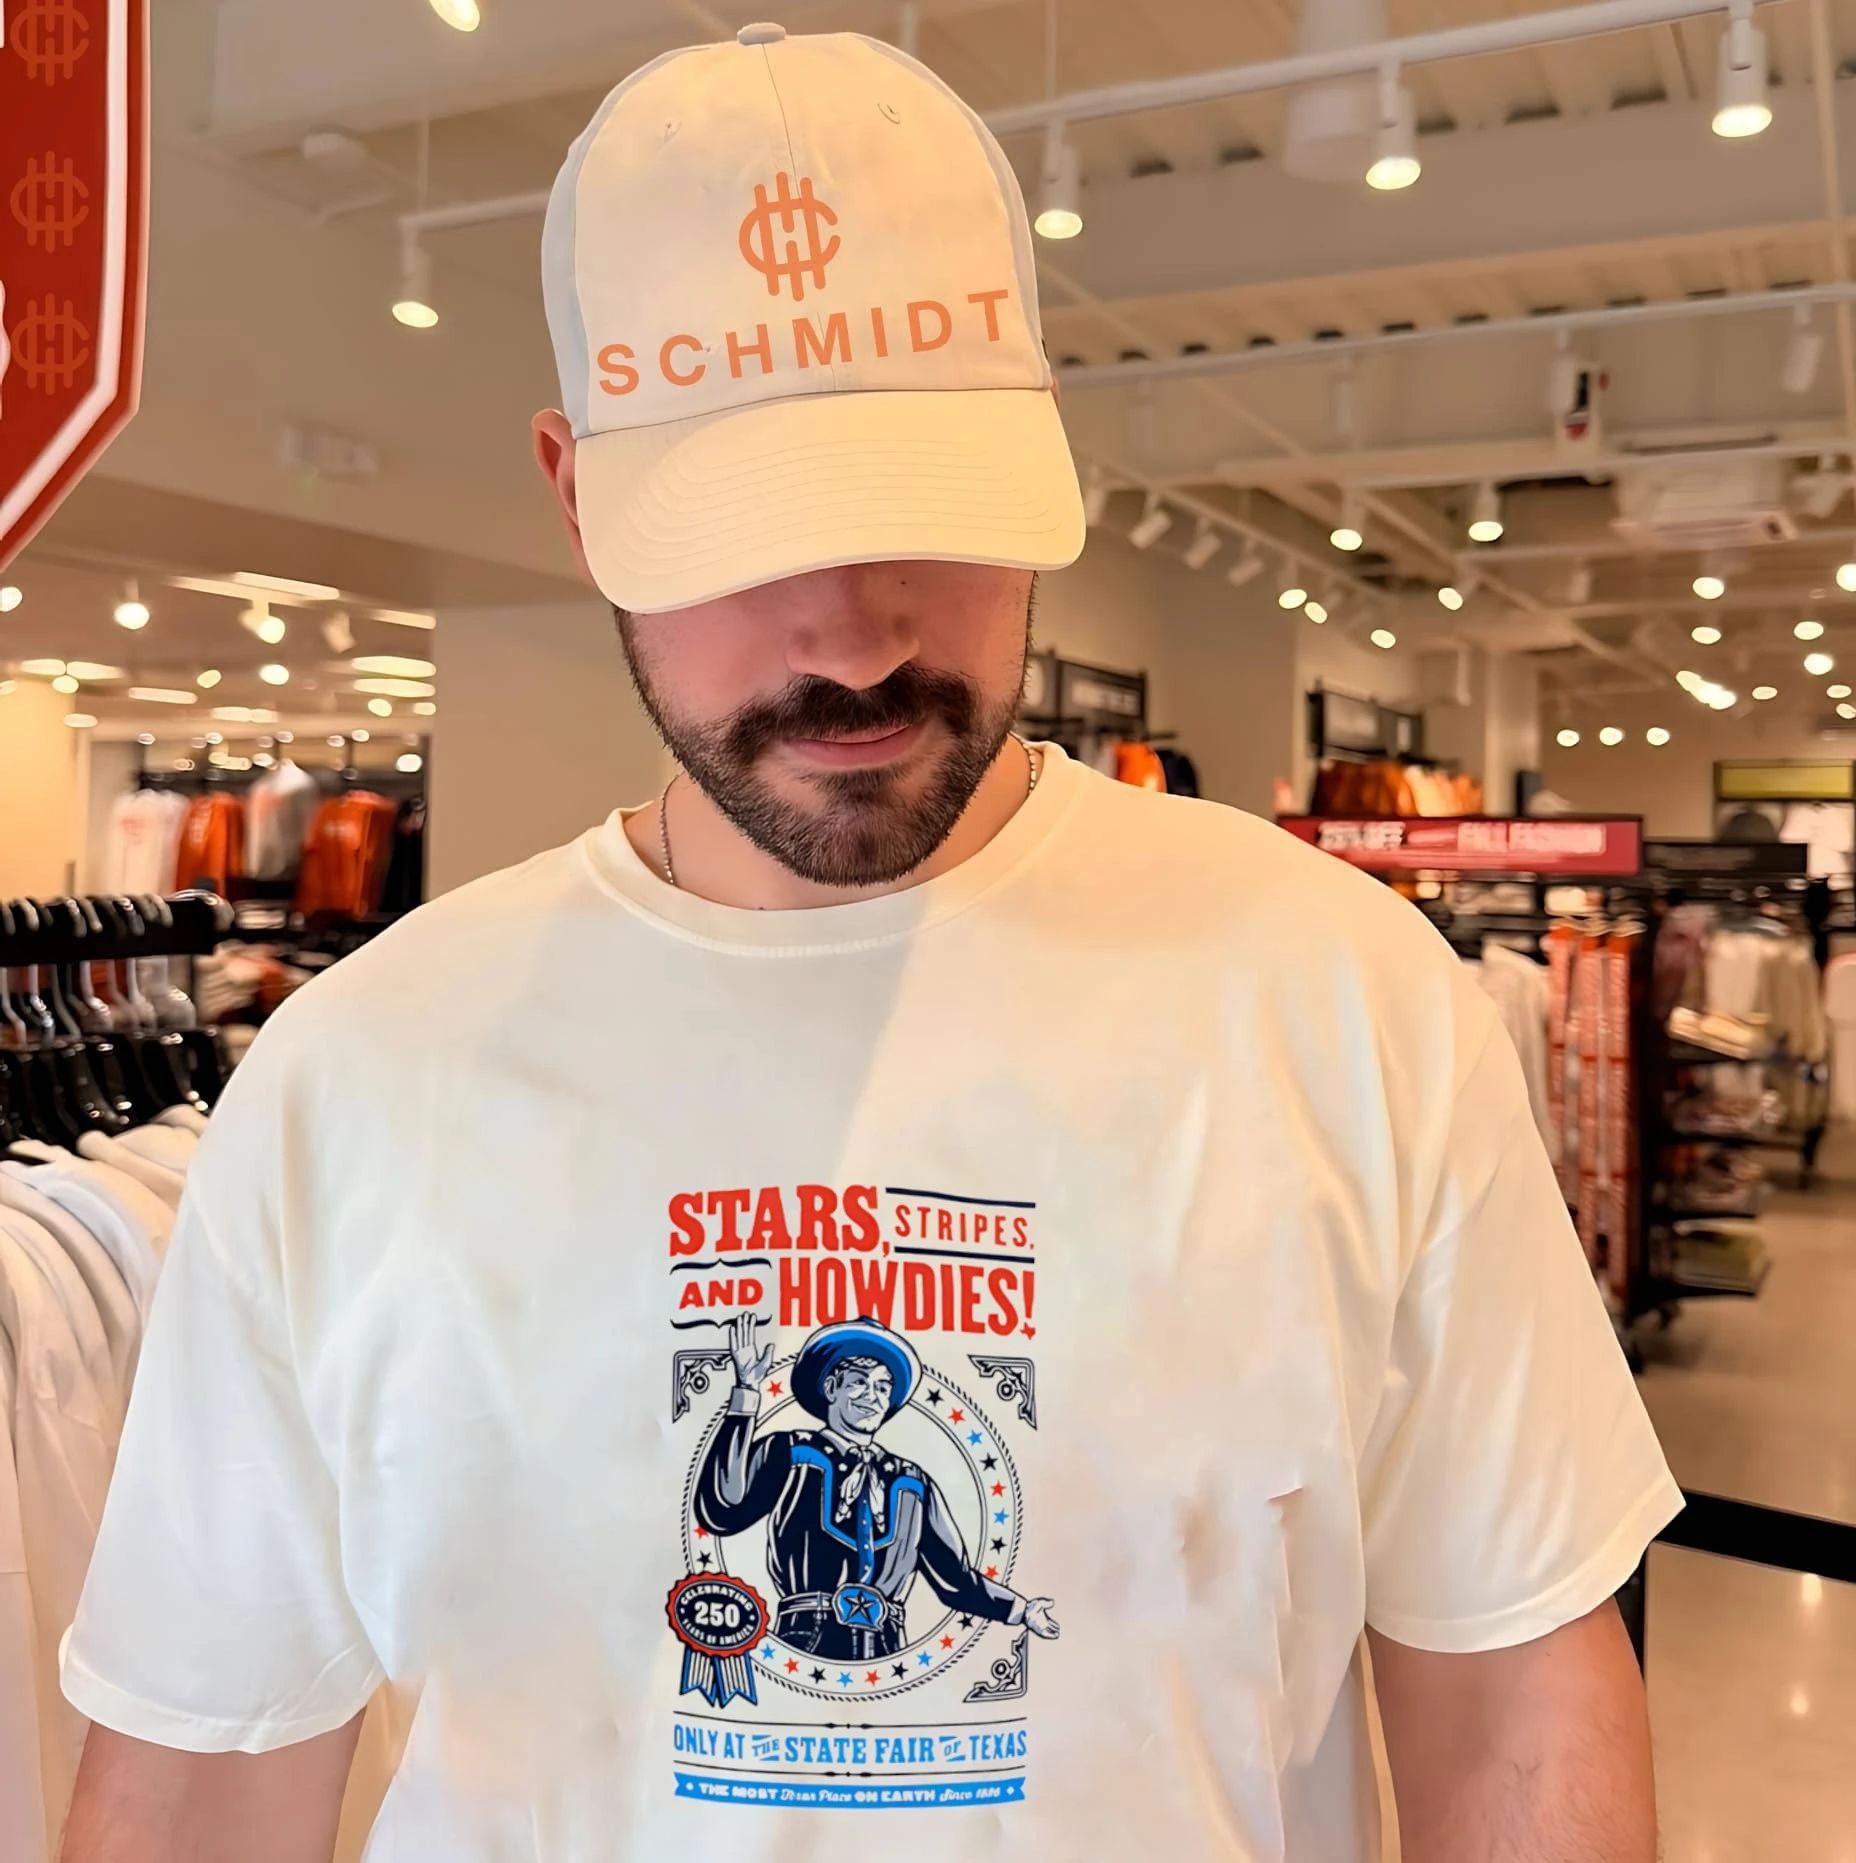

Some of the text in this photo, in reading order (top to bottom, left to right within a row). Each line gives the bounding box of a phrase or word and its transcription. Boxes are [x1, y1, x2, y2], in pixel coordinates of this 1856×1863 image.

[598, 289, 1010, 395] SCHMIDT
[669, 1184, 891, 1257] STARS,
[679, 1256, 1037, 1340] AND HOWDIES!
[694, 1601, 740, 1628] 250
[673, 1723, 719, 1757] ONLY
[723, 1731, 746, 1760] AT
[752, 1738, 780, 1757] THE
[784, 1736, 868, 1765] STATE
[874, 1736, 936, 1765] FAIR
[969, 1729, 1028, 1761] TEXAS
[699, 1783, 729, 1796] THE
[732, 1787, 778, 1800] MOST
[854, 1791, 878, 1803] ON
